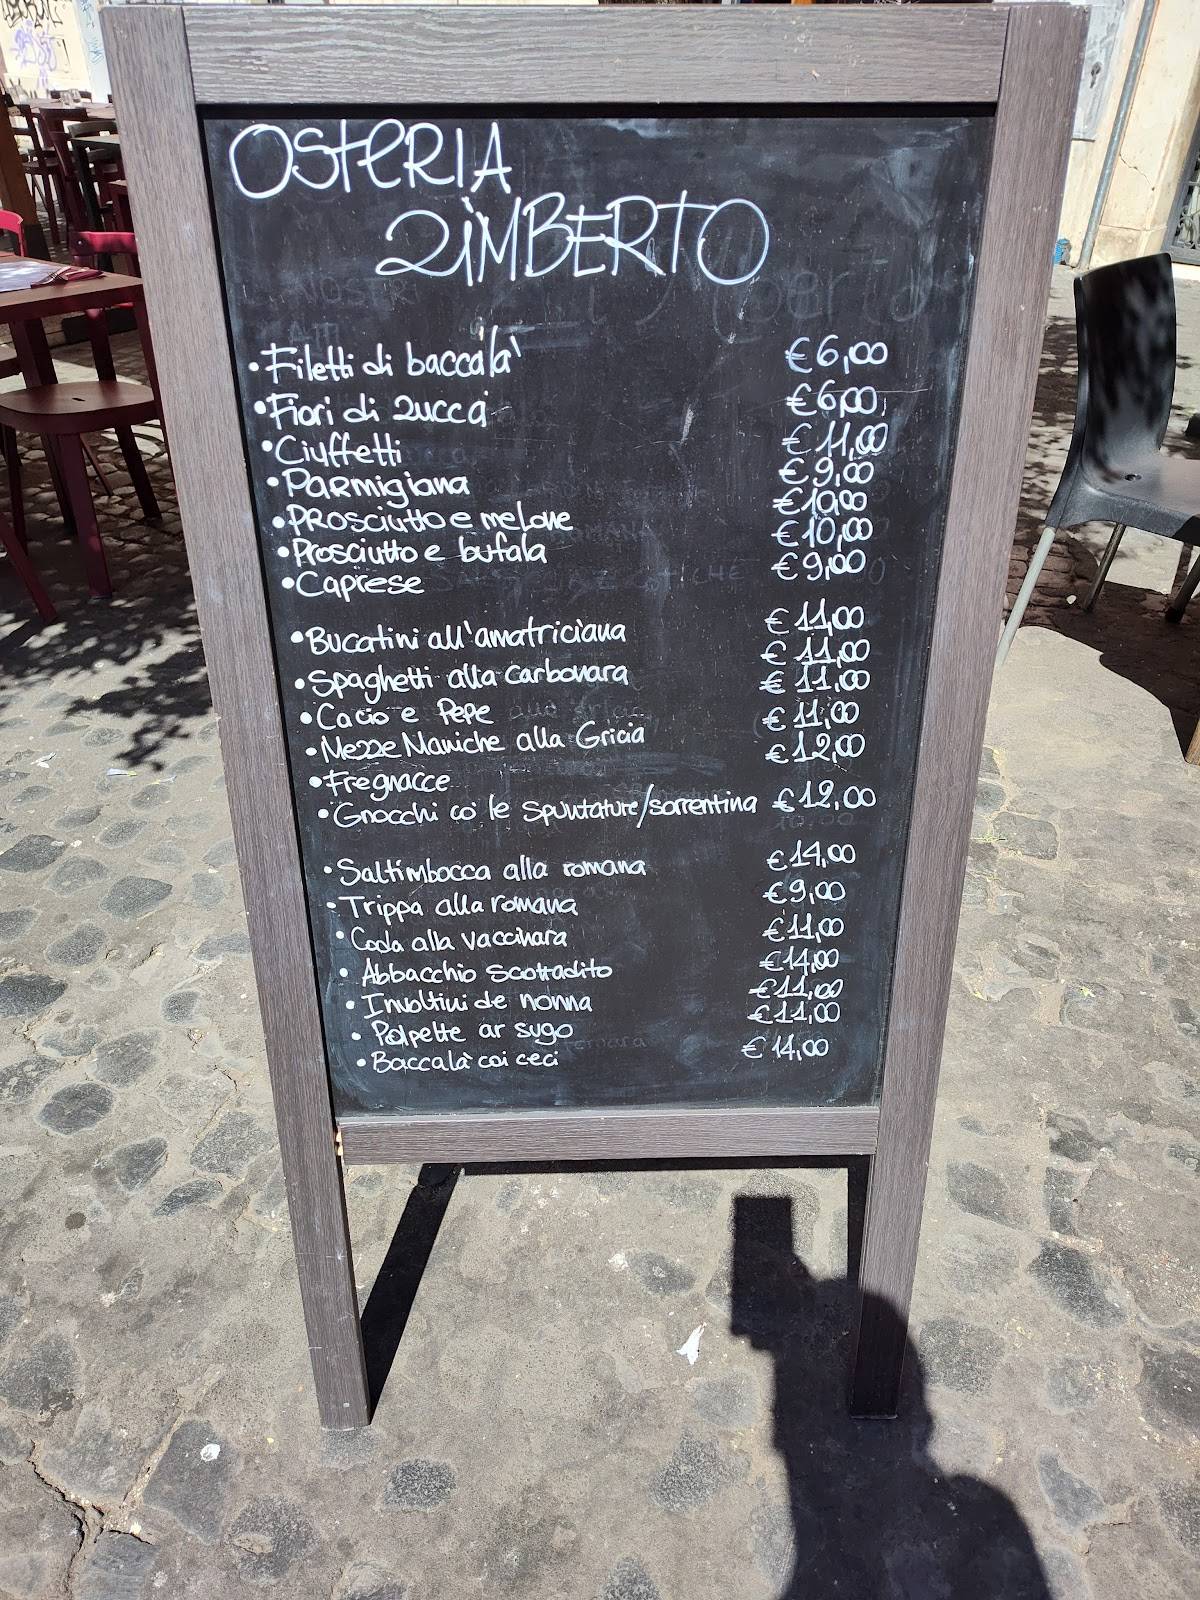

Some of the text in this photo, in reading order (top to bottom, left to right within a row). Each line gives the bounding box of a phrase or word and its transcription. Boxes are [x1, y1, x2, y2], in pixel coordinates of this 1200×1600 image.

[260, 342, 354, 385] Filetti
[362, 342, 393, 377] di
[266, 392, 334, 430] Fiori
[343, 392, 380, 422] di
[275, 431, 402, 467] Ciuffetti
[450, 510, 473, 529] e
[292, 537, 418, 567] Prosciutto
[424, 542, 445, 562] e
[458, 531, 548, 564] bufala
[296, 570, 425, 602] Caprese
[305, 624, 420, 656] Bucatini
[308, 664, 434, 704] Spaghetti
[448, 663, 497, 689] alla
[316, 702, 390, 731] Cacio
[401, 706, 419, 723] e
[401, 731, 505, 758] Maniche
[516, 724, 566, 752] alla
[575, 720, 646, 749] Gricia
[322, 769, 451, 802] Fregnacce
[333, 801, 438, 829] Gnocchi
[488, 793, 511, 821] le
[336, 854, 648, 887] Saltimbocca alla romana
[337, 891, 578, 926] Trippa alla romana
[350, 926, 405, 954] Coda
[411, 928, 456, 952] alla
[361, 957, 477, 988] Abbacchio
[360, 989, 593, 1020] Involtini de nonna
[371, 1020, 467, 1049] Polpette
[478, 1018, 505, 1038] ar
[514, 1020, 574, 1045] sugo
[370, 1050, 559, 1074] Baccalà coi ceci
